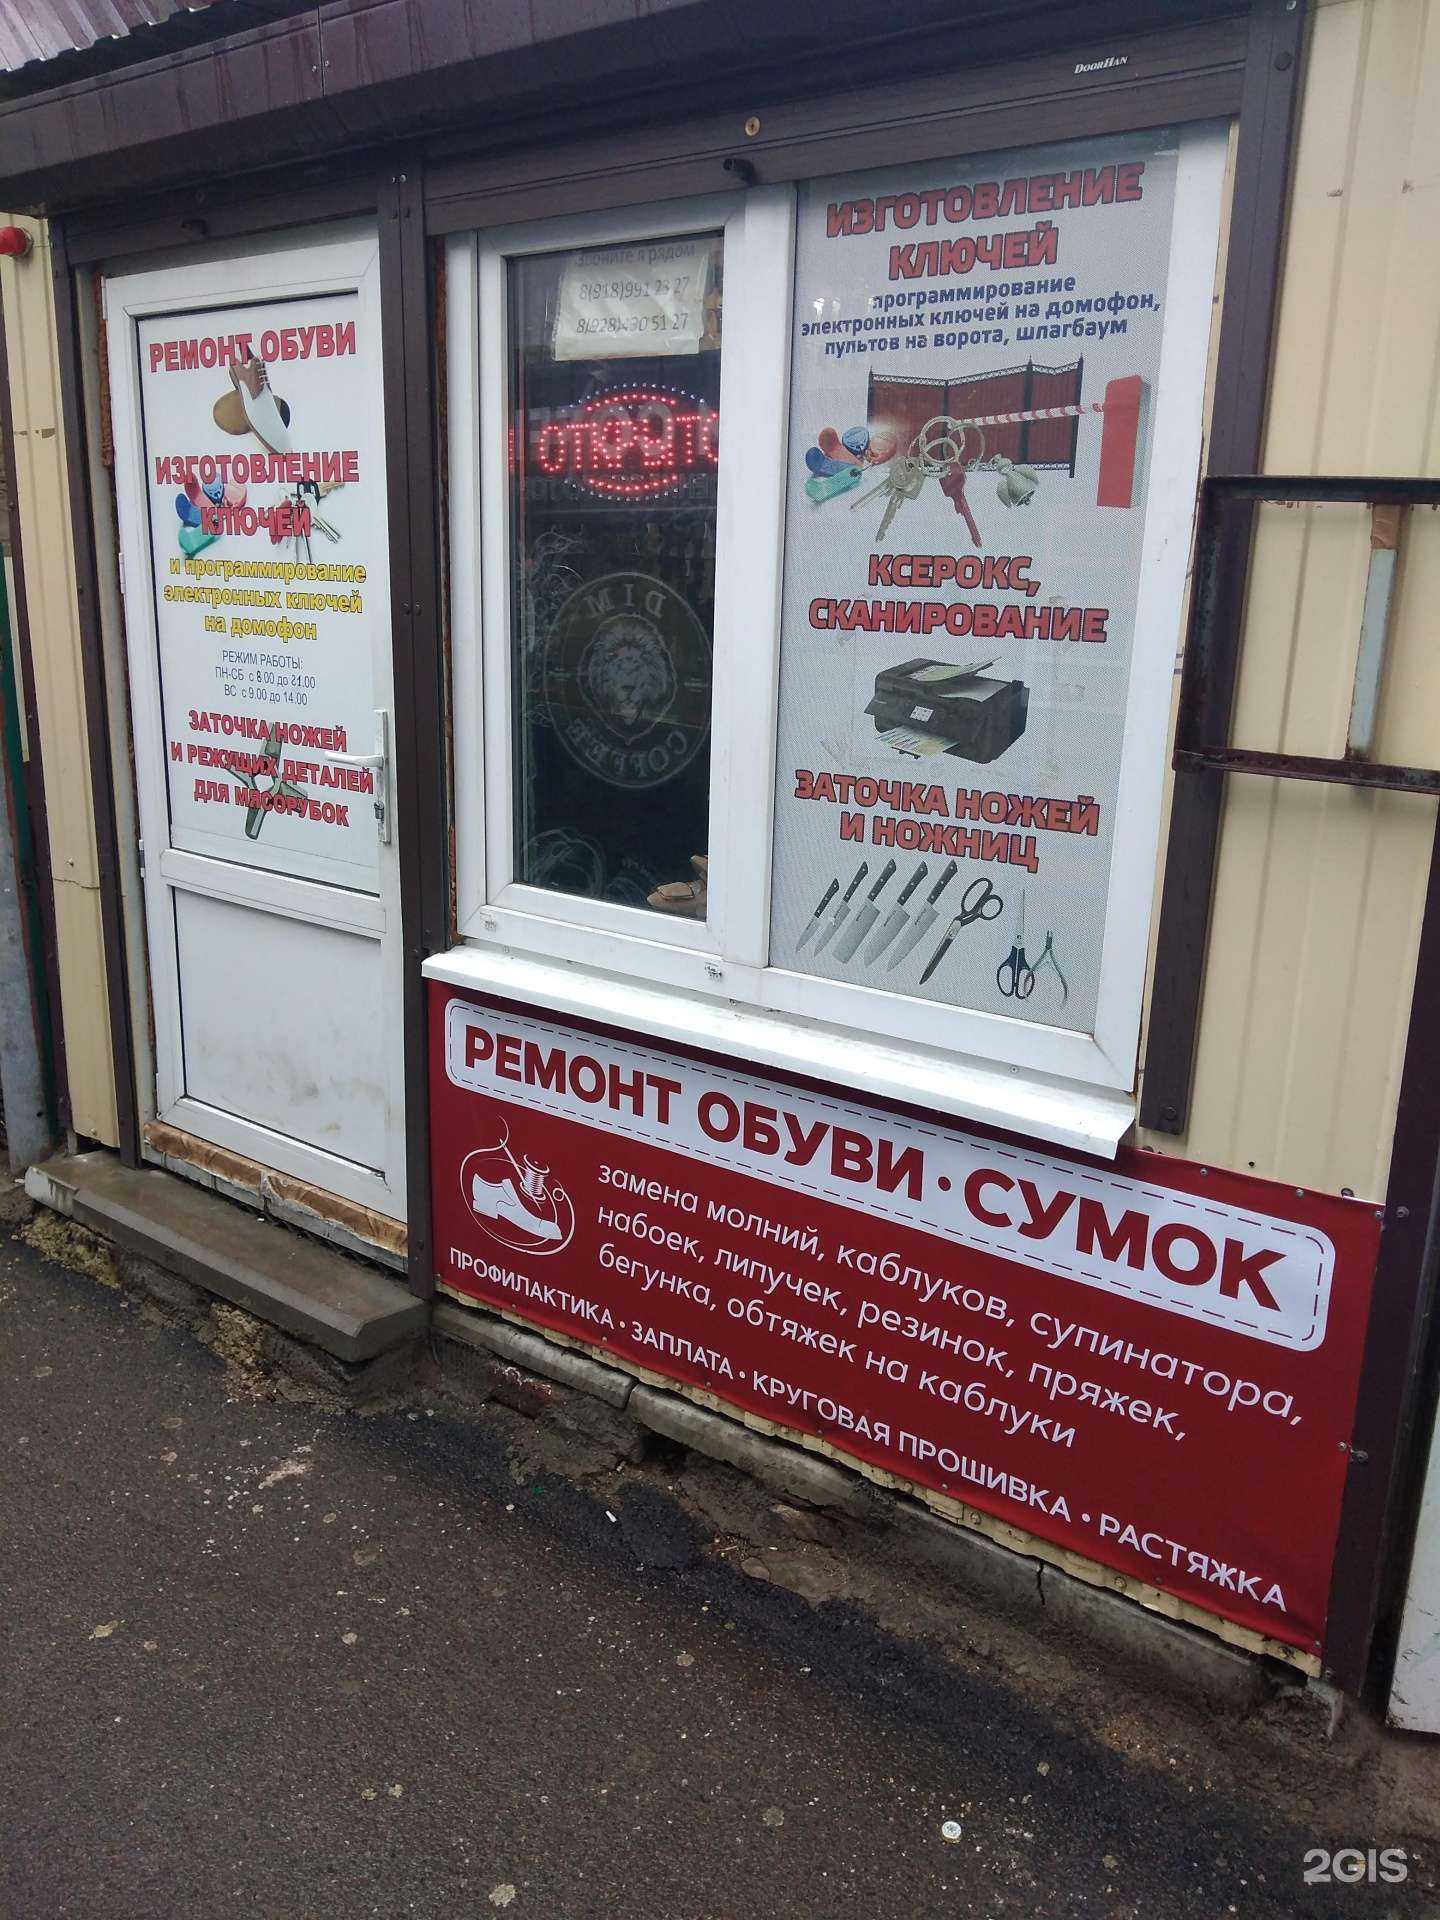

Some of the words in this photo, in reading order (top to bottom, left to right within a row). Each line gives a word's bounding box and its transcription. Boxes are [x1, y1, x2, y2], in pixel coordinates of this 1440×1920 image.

[826, 162, 1145, 238] ИЗГОТОВЛЕНИЕ
[889, 220, 1059, 280] КЛЮЧЕЙ
[801, 309, 925, 337] электронных
[930, 302, 1009, 327] ключей
[1015, 302, 1039, 319] на
[1045, 292, 1161, 319] домофон,
[873, 275, 1076, 311] программирование
[150, 333, 253, 373] РЕМОНТ
[260, 321, 356, 363] ОБУВИ
[824, 328, 899, 357] пультов
[905, 333, 928, 350] на
[933, 328, 1009, 351] ворота,
[1015, 316, 1128, 345] шлагбаум
[155, 451, 360, 485] ИЗГОТОВЛЕНИЕ
[200, 501, 312, 537] КЛЮЧЕЙ
[170, 558, 180, 574] и
[185, 559, 367, 584] программирование
[868, 553, 1041, 597] КСЕРОКС,
[164, 584, 281, 609] электронных
[286, 590, 363, 613] ключей
[808, 597, 1109, 643] СКАНИРОВАНИЕ
[204, 616, 226, 633] на
[231, 616, 317, 643] домофон
[215, 666, 244, 680] ПН-СБ
[277, 676, 289, 687] до
[222, 650, 257, 665] РЕЖИМ
[260, 654, 303, 670] РАБОТЫ:
[224, 684, 237, 697] ВС
[248, 687, 267, 700] 9.00
[269, 692, 281, 703] до
[283, 691, 308, 706] 14.00
[189, 709, 273, 740] ЗАТОЧКА
[275, 722, 347, 752] НОЖЕЙ
[171, 741, 183, 761] И
[187, 744, 278, 777] РЕЖУЩИХ
[282, 758, 374, 794] ДЕТАЛЕЙ
[194, 779, 230, 803] ДЛЯ
[234, 786, 349, 827] МЯСОРУБОК
[794, 769, 950, 818] ЗАТОЧКА
[955, 788, 1101, 837] НОЖЕЙ
[840, 811, 865, 843] И
[872, 816, 1040, 874] НОЖНИЦ
[465, 1023, 682, 1126] РЕМОНТ
[697, 1091, 925, 1202] ОБУВИ
[963, 1167, 1288, 1313] СУМОК
[598, 1164, 698, 1214] замена
[706, 1196, 824, 1262] молний,
[837, 1245, 1015, 1328] каблуков,
[1029, 1311, 1303, 1426] супинатора,
[598, 1205, 705, 1263] набоек,
[715, 1249, 847, 1316] липучек,
[857, 1300, 1014, 1378] резинок,
[1029, 1361, 1187, 1441] пряжек,
[599, 1242, 717, 1311] бегунка,
[727, 1294, 857, 1363] обтяжек
[866, 1349, 909, 1384] на
[918, 1368, 1076, 1449] каблуки
[449, 1247, 614, 1330] ПРОФИЛАКТИКА
[631, 1320, 735, 1379] ЗАПЛАТА
[753, 1370, 890, 1449] КРУГОВАЯ
[898, 1430, 1072, 1523] ПРОШИВКА
[1098, 1513, 1287, 1612] РАСТЯЖКА
